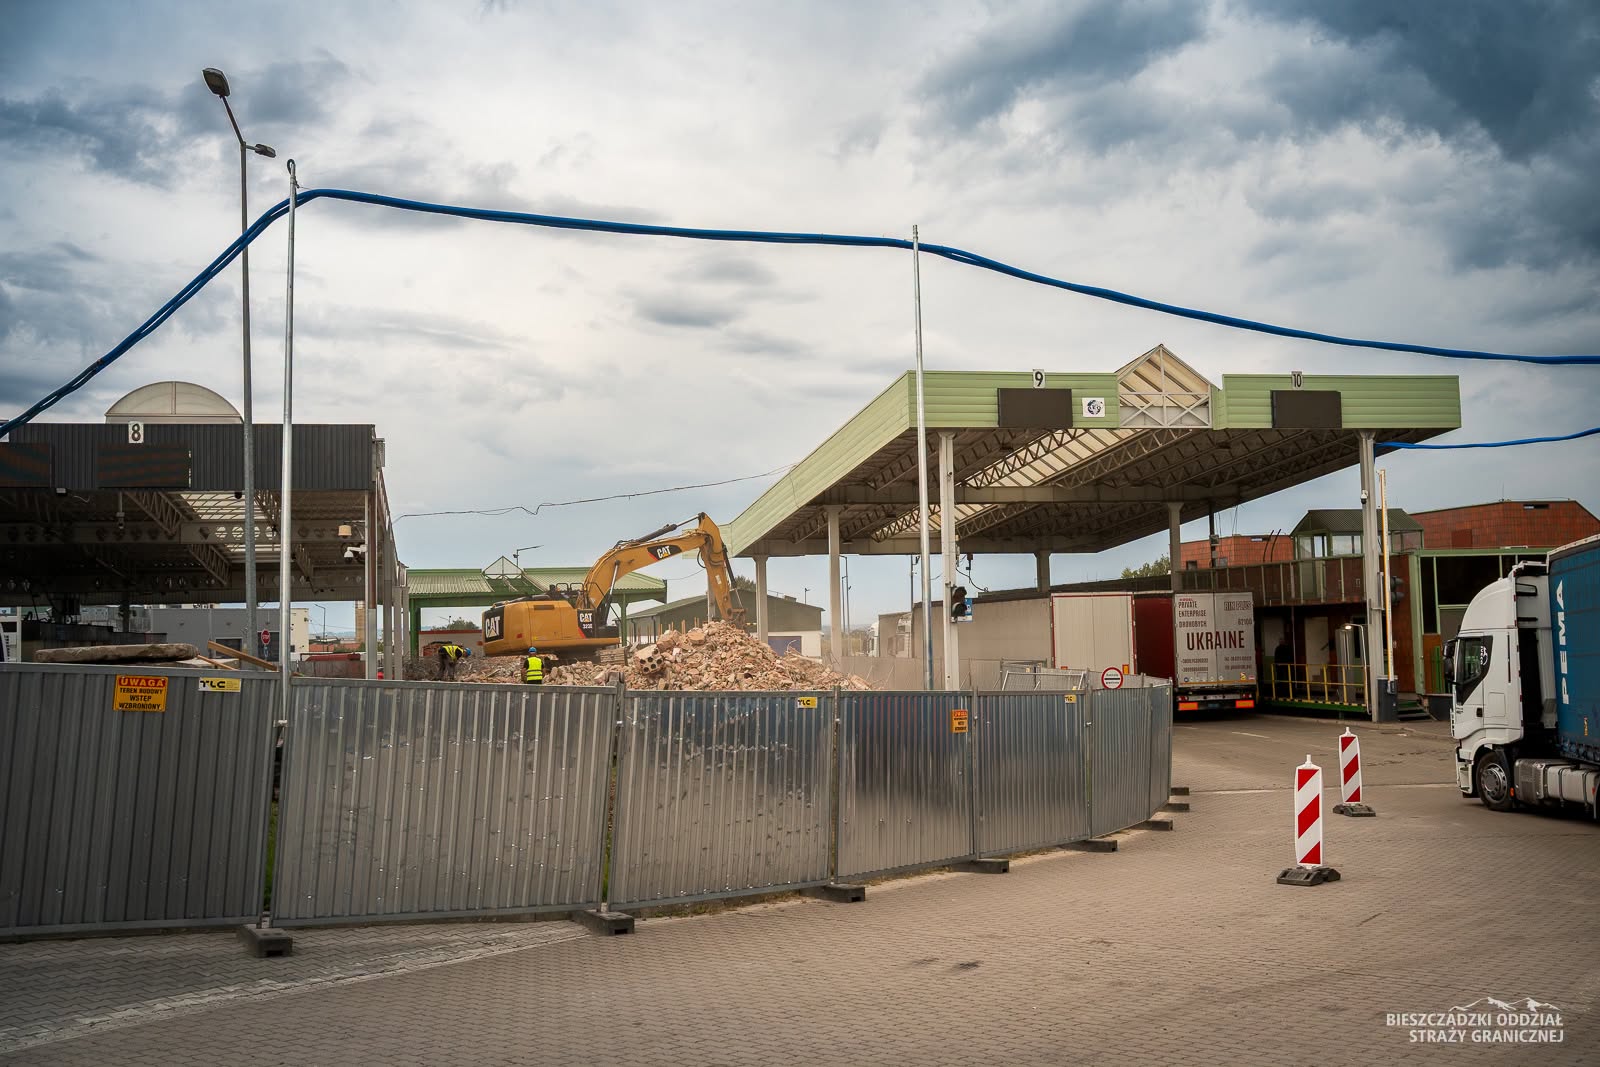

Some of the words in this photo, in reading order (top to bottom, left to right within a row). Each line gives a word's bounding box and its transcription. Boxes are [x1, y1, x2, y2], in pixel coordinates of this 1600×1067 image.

[1035, 371, 1044, 387] 9
[1293, 373, 1302, 388] 10
[131, 423, 141, 441] 8
[656, 545, 671, 559] CAT
[579, 612, 593, 622] CAT
[485, 615, 500, 638] CAT
[1186, 630, 1245, 650] UKRAINE
[1556, 579, 1570, 705] PEMA
[120, 678, 164, 687] UWAGA
[200, 680, 226, 688] TLC
[119, 702, 161, 710] WZBRONIONY
